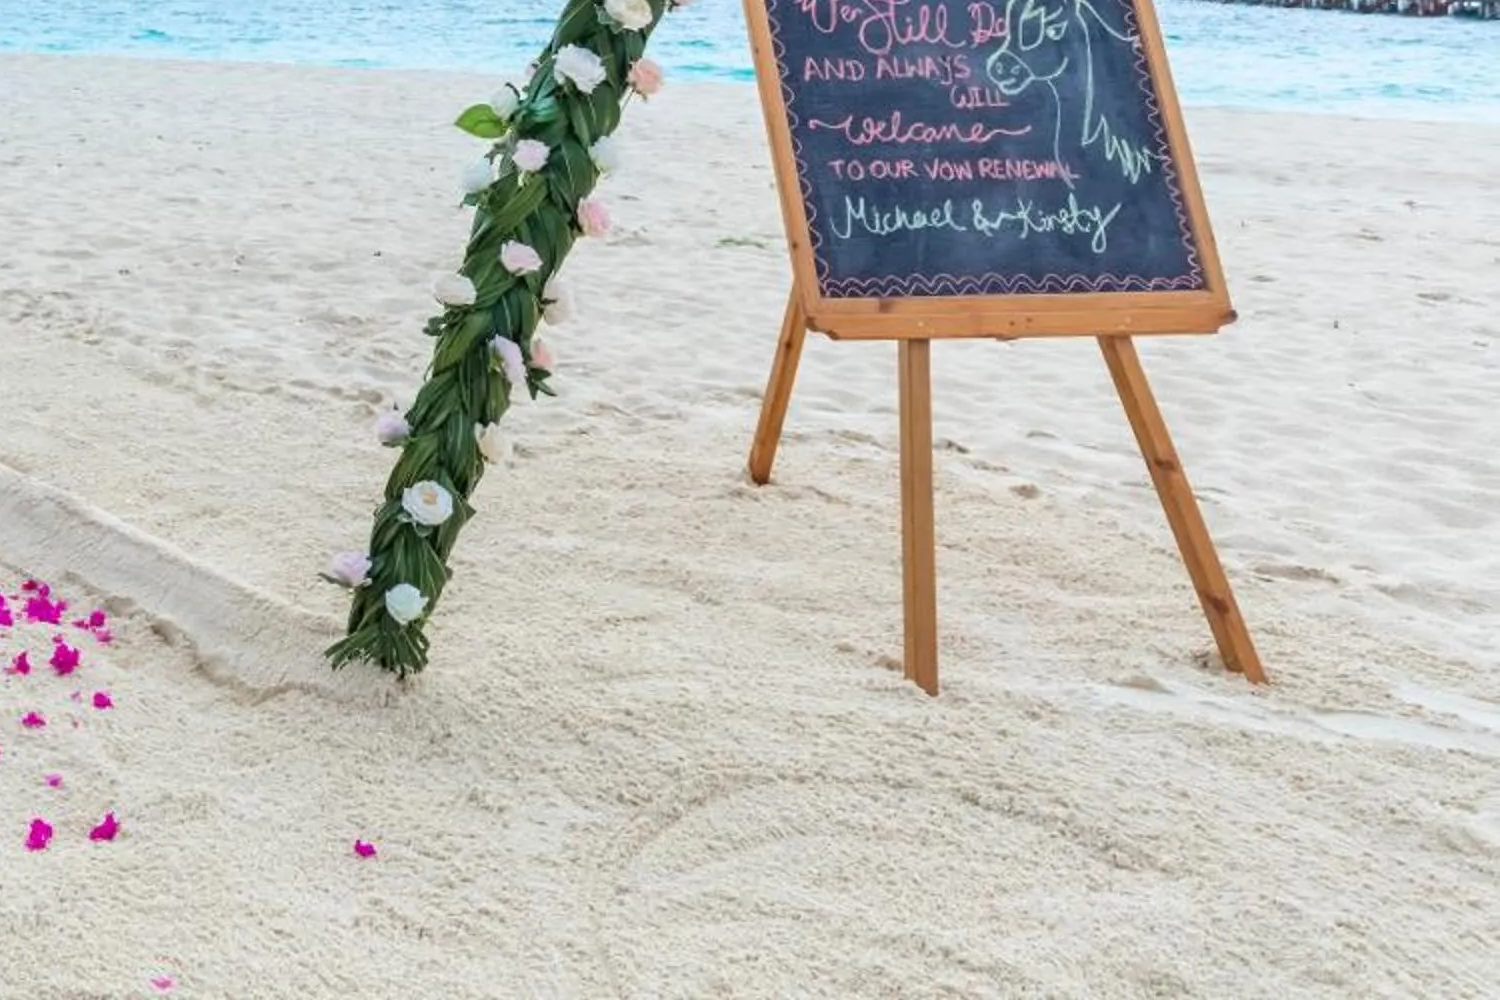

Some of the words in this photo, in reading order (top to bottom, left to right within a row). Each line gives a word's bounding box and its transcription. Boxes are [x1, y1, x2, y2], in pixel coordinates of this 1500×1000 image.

[967, 0, 1012, 49] Do
[804, 56, 865, 81] AND
[876, 53, 972, 85] ALWAYS
[951, 86, 1010, 109] WILL
[827, 159, 864, 181] TO
[869, 159, 920, 179] OUR
[924, 157, 974, 181] VOW
[978, 159, 1082, 180] RENEWAL
[829, 195, 967, 239] Michael
